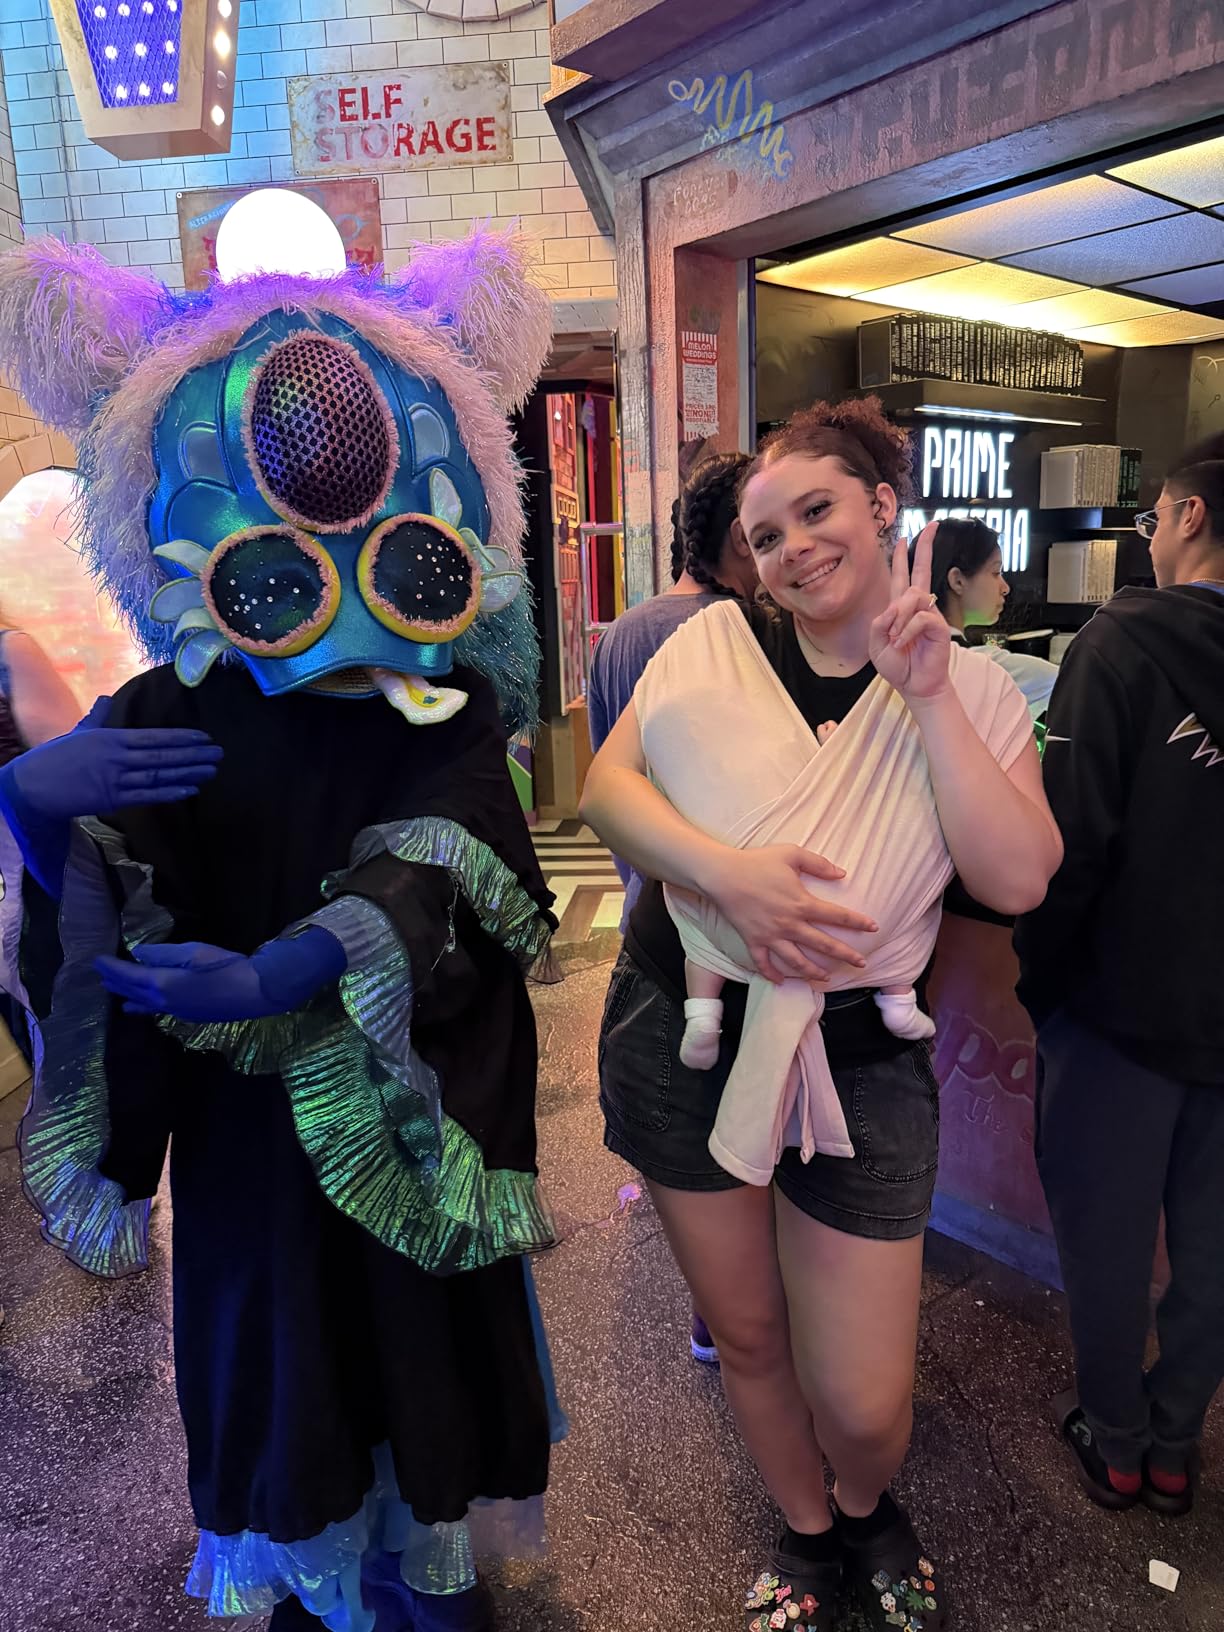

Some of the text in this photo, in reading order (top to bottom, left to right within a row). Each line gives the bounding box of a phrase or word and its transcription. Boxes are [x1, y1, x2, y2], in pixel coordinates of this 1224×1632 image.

[314, 84, 402, 125] SELF
[315, 117, 497, 162] STORAGE
[683, 350, 717, 359] WEDDINGS
[688, 342, 711, 350] MELON
[922, 426, 1015, 499] PRIME
